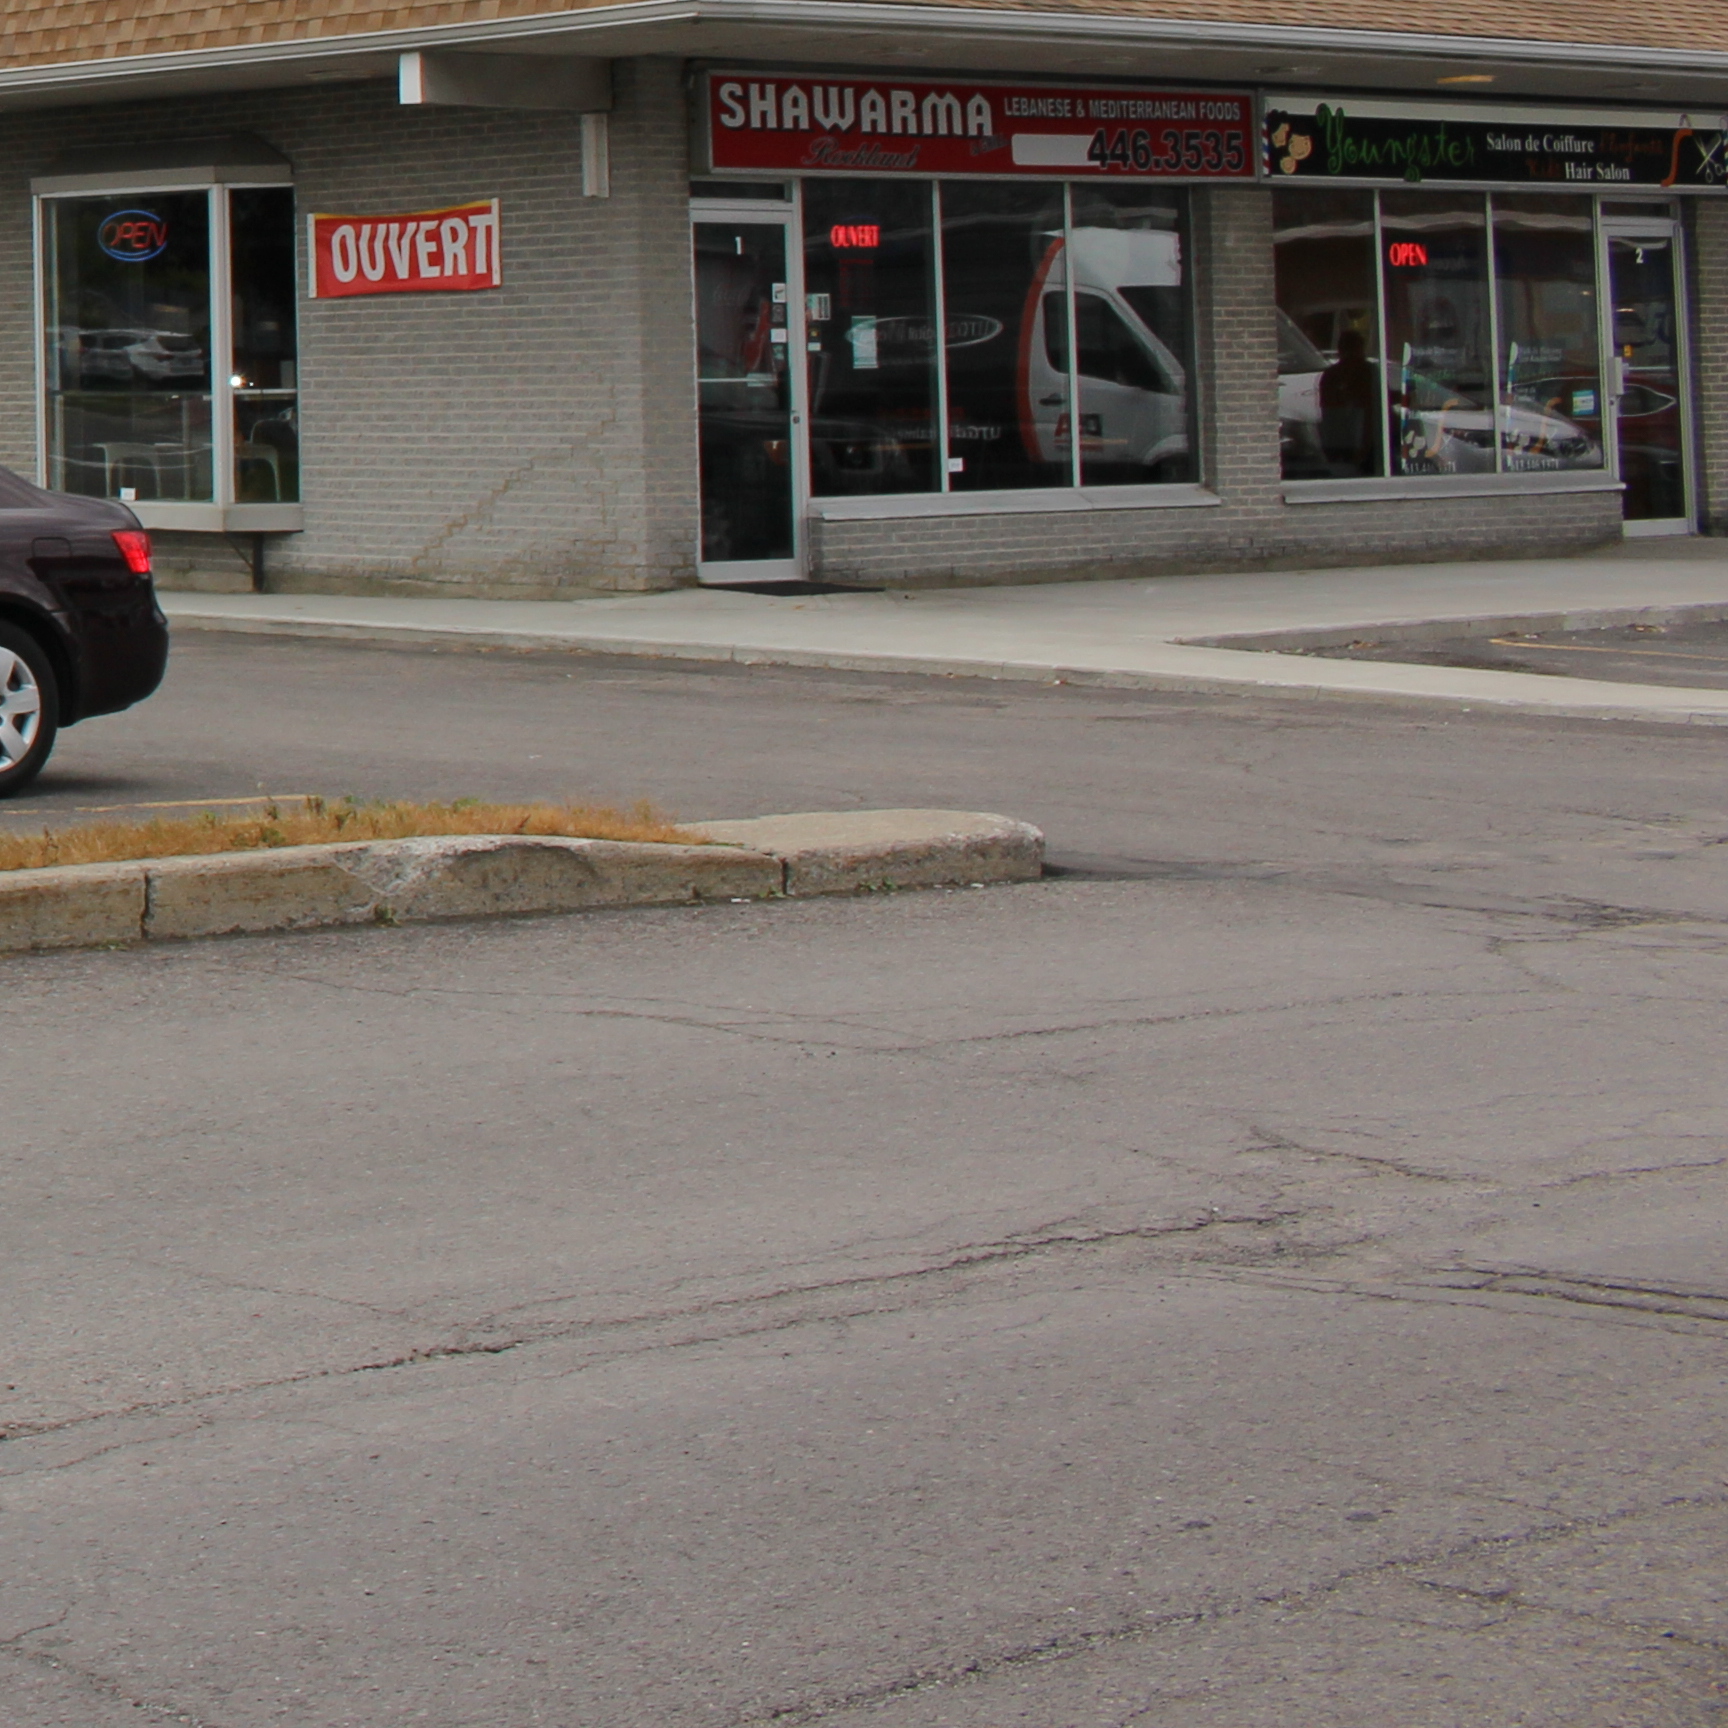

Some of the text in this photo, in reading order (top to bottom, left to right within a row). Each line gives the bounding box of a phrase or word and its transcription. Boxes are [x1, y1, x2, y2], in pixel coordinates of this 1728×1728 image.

[719, 82, 993, 137] SHAWARMA
[1004, 97, 1241, 120] LEBANESE & MEDITERRANEAN FOODS
[1087, 128, 1244, 171] 446.3535
[1315, 102, 1475, 182] Youngster
[1486, 132, 1522, 152] Salon
[1525, 135, 1540, 152] de
[1543, 133, 1595, 153] Coiffure
[1565, 161, 1593, 180] Hair
[1596, 162, 1631, 181] Salon
[101, 220, 170, 250] OPEN
[735, 236, 743, 255] 1
[830, 224, 881, 248] OUVERT
[331, 213, 494, 283] OUVERT
[1389, 242, 1428, 267] OPEN
[1635, 248, 1644, 264] 2
